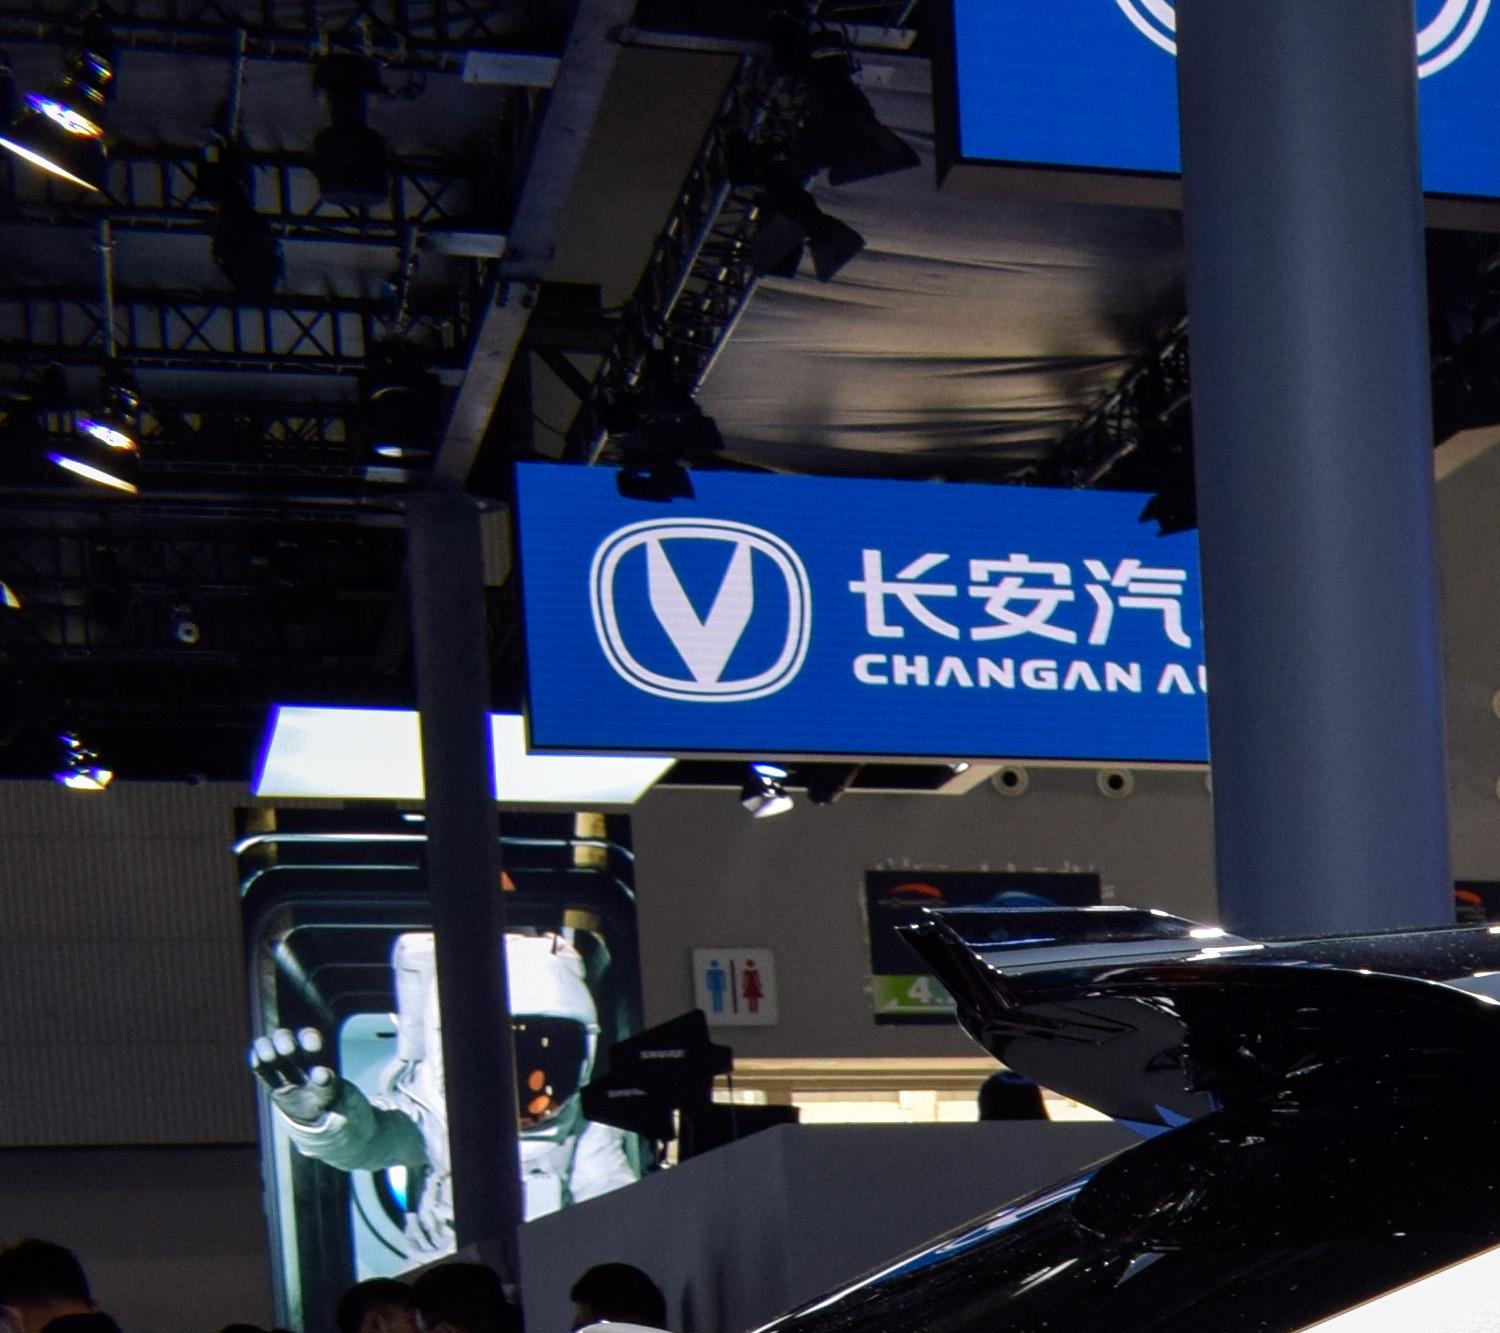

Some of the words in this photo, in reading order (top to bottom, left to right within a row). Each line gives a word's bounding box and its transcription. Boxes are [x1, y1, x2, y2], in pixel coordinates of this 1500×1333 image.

[849, 549, 1192, 650] 长安汽
[852, 652, 1142, 694] CHANGAN
